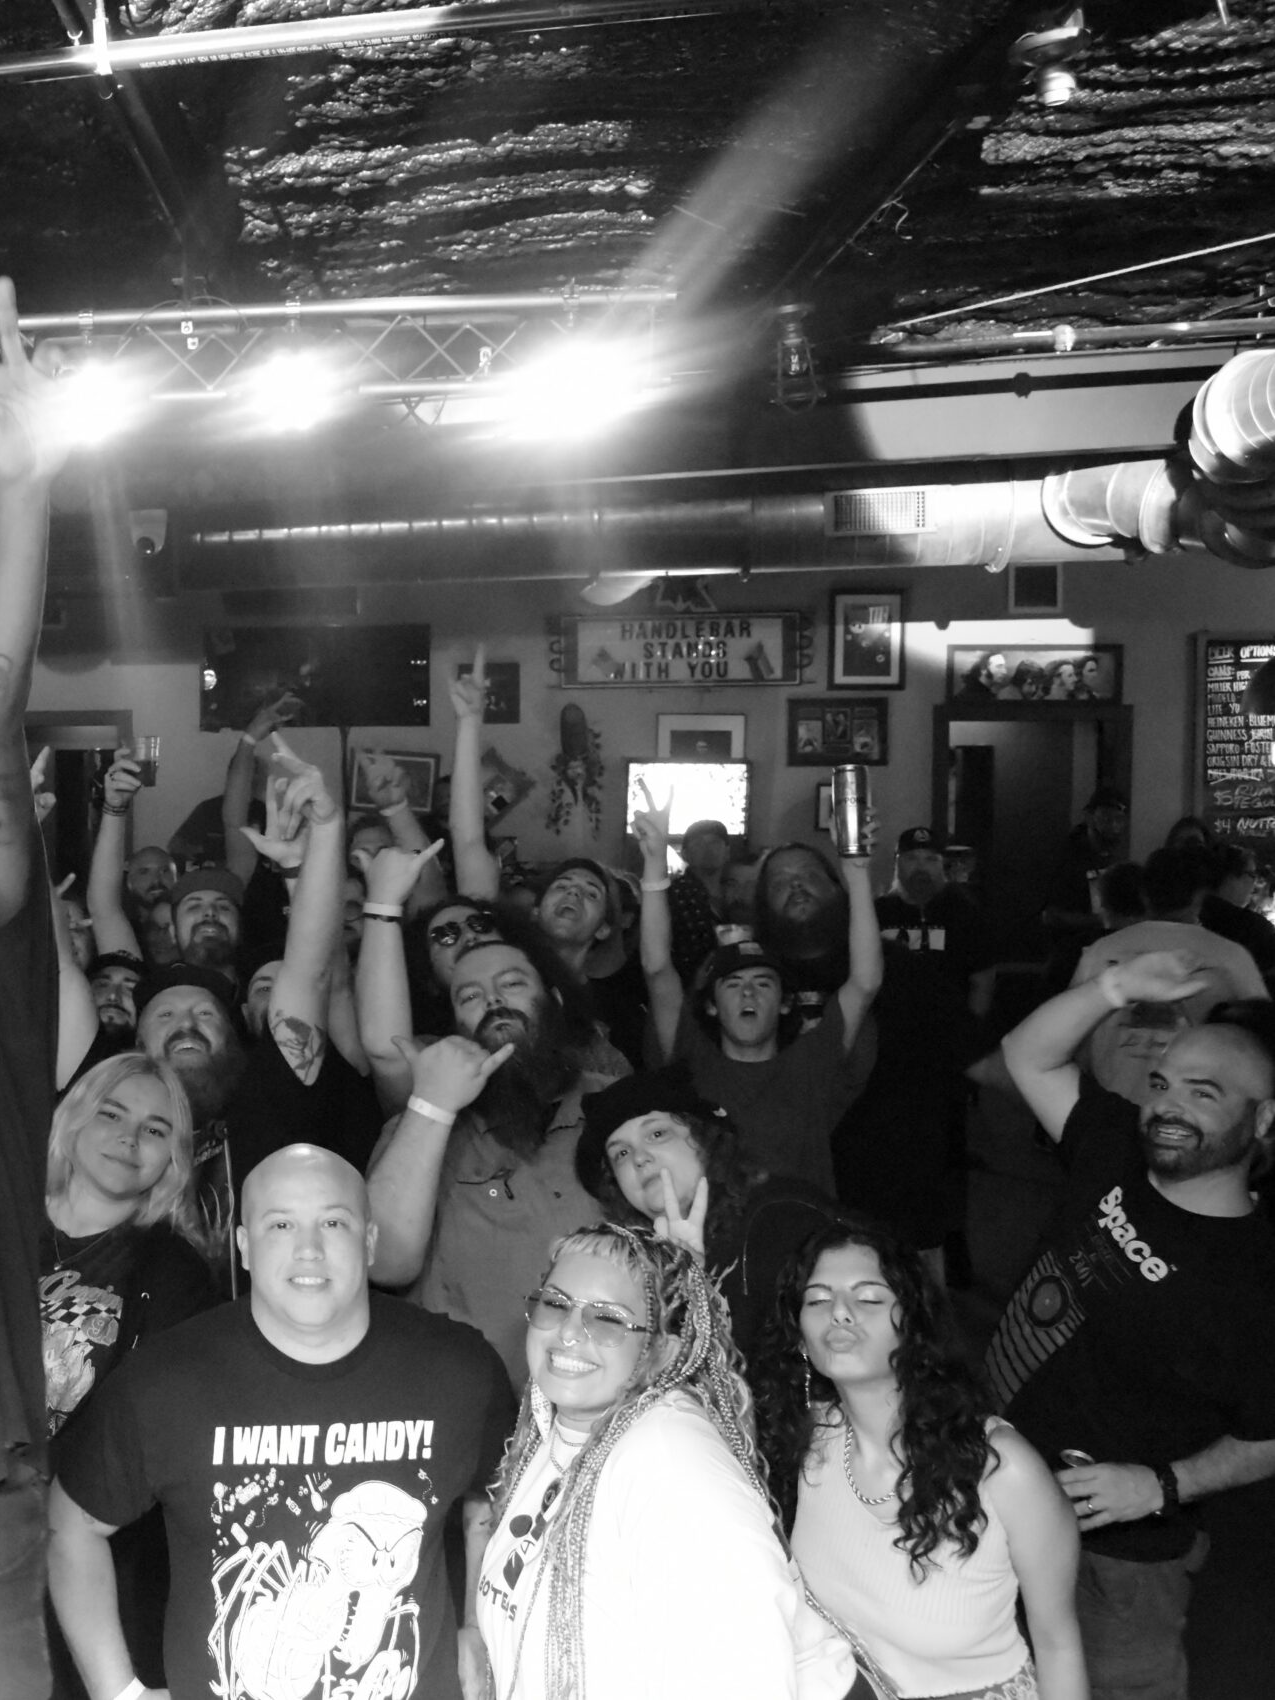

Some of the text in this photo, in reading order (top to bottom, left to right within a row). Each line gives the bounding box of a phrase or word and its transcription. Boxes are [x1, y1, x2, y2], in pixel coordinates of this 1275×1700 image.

[621, 620, 752, 639] HANDLEBAR
[643, 640, 728, 660] STANDS
[687, 661, 729, 679] YOU
[1207, 715, 1244, 729] HEINEKEN
[1206, 729, 1248, 742] GUINNESS
[1097, 1186, 1169, 1282] Space
[212, 1420, 434, 1466] I WANT CANDY!
